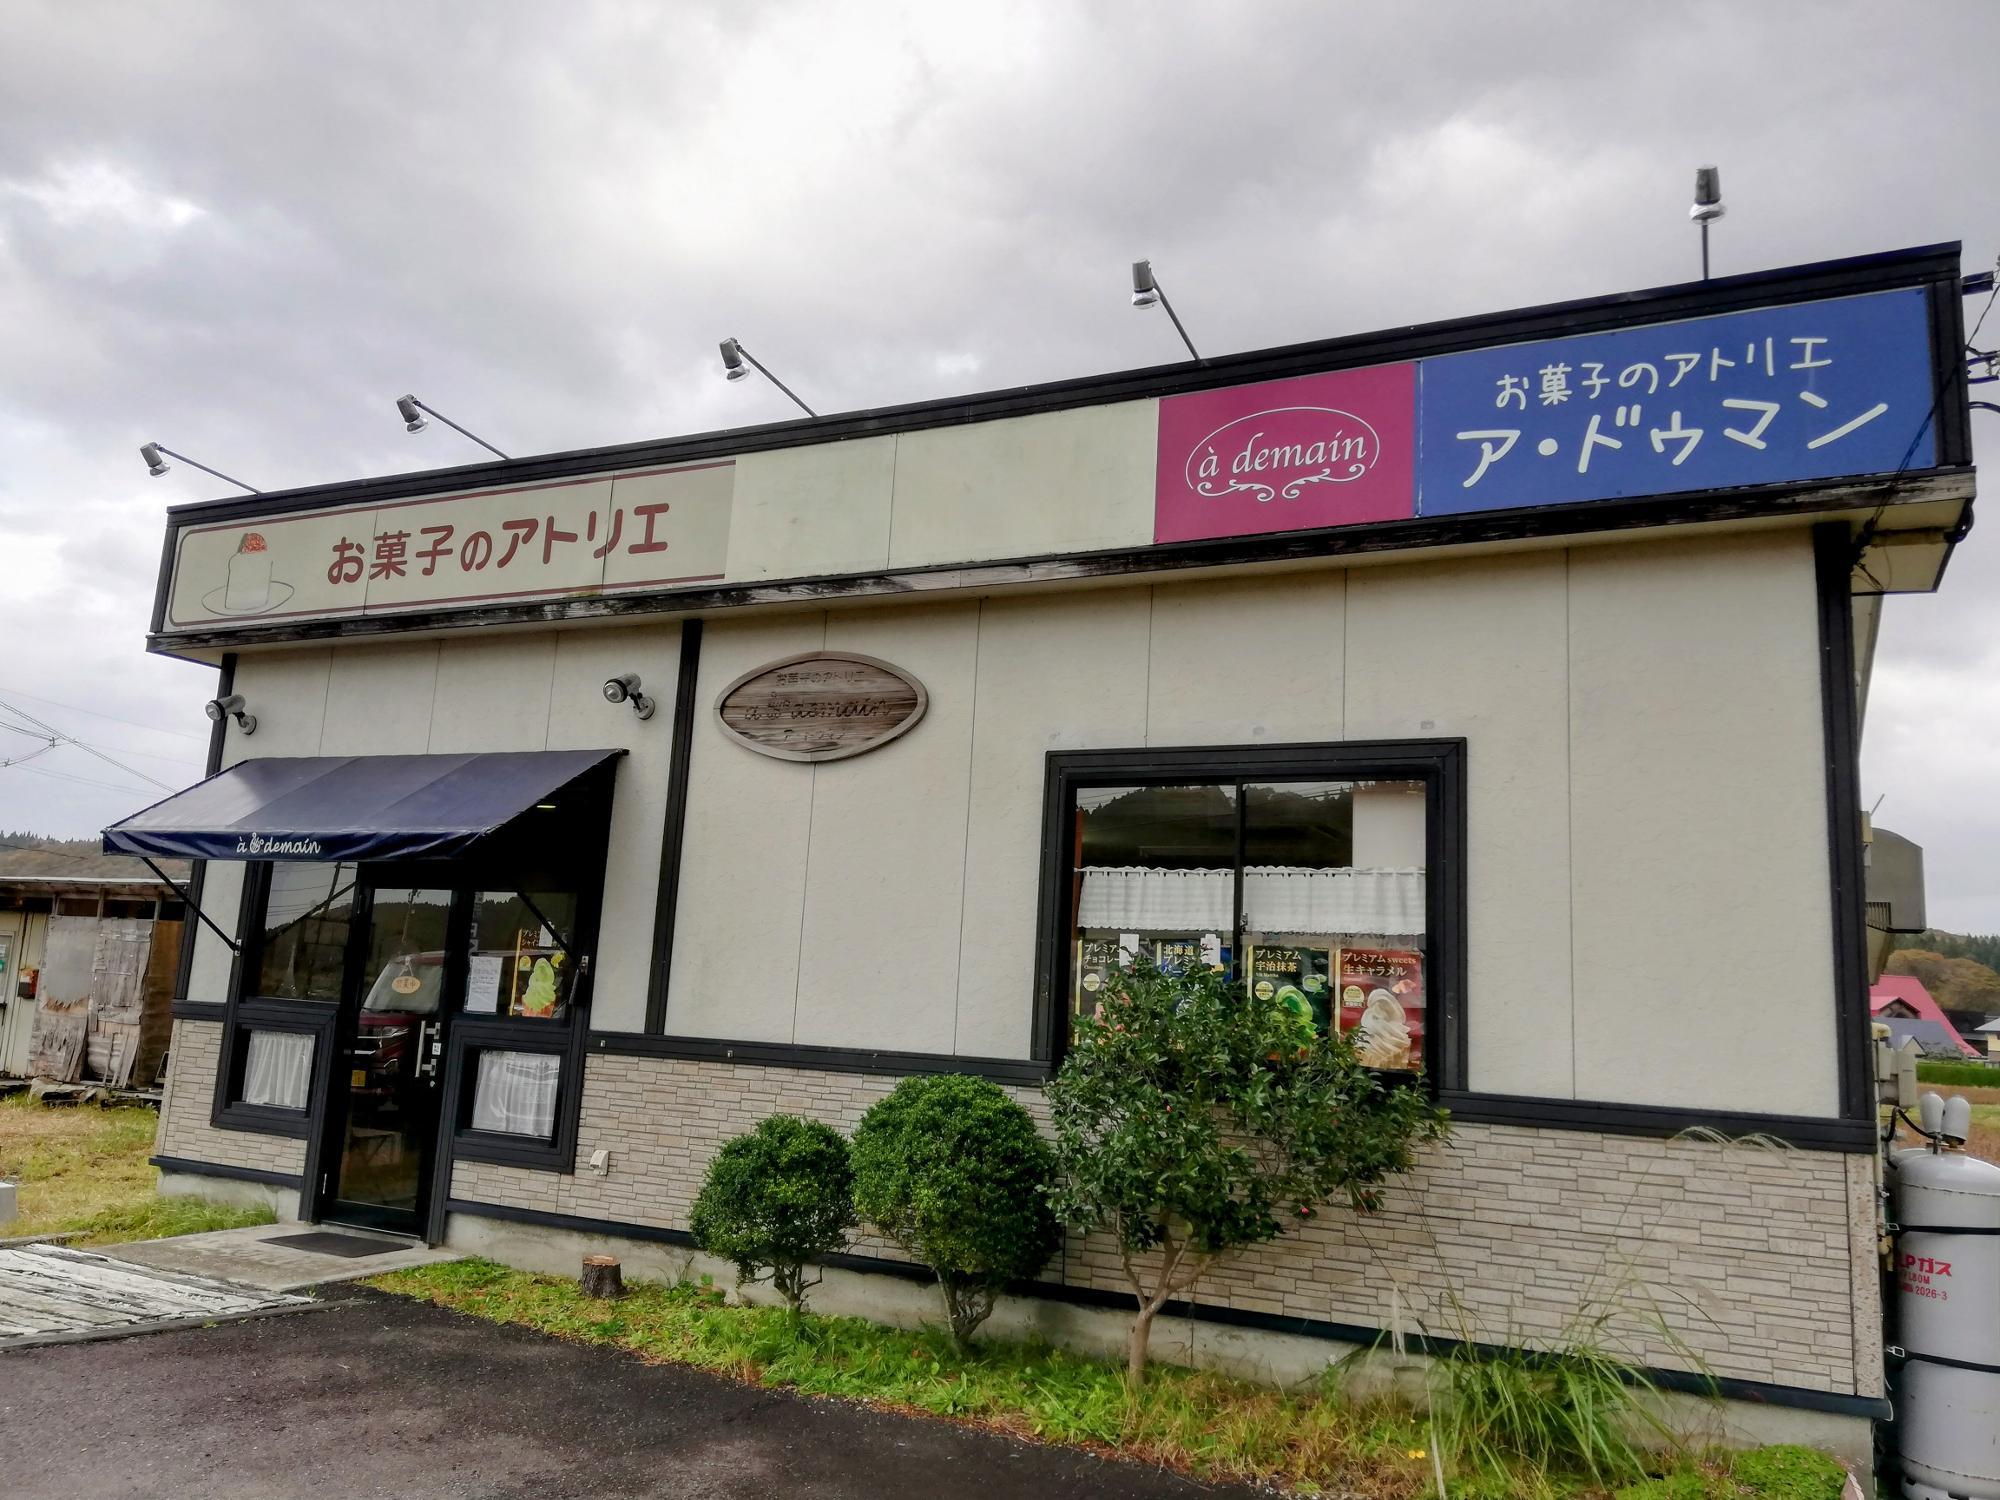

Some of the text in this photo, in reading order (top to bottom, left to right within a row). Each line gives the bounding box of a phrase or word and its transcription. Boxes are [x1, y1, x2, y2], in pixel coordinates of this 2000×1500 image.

[1495, 337, 1832, 410] お菓子のアトリエ
[1199, 429, 1367, 478] à demain
[327, 503, 670, 585] お菓子のアトリエ
[236, 836, 321, 854] à demain
[1164, 944, 1194, 956] 北海道
[1255, 950, 1302, 961] プレミアム
[1084, 954, 1119, 964] チョコレー
[1343, 953, 1417, 965] プレミアム sweets
[1256, 961, 1297, 973] 宇治抹茶
[1343, 964, 1408, 977] 生キャラメル
[1915, 1285, 1948, 1301] 2026-3
